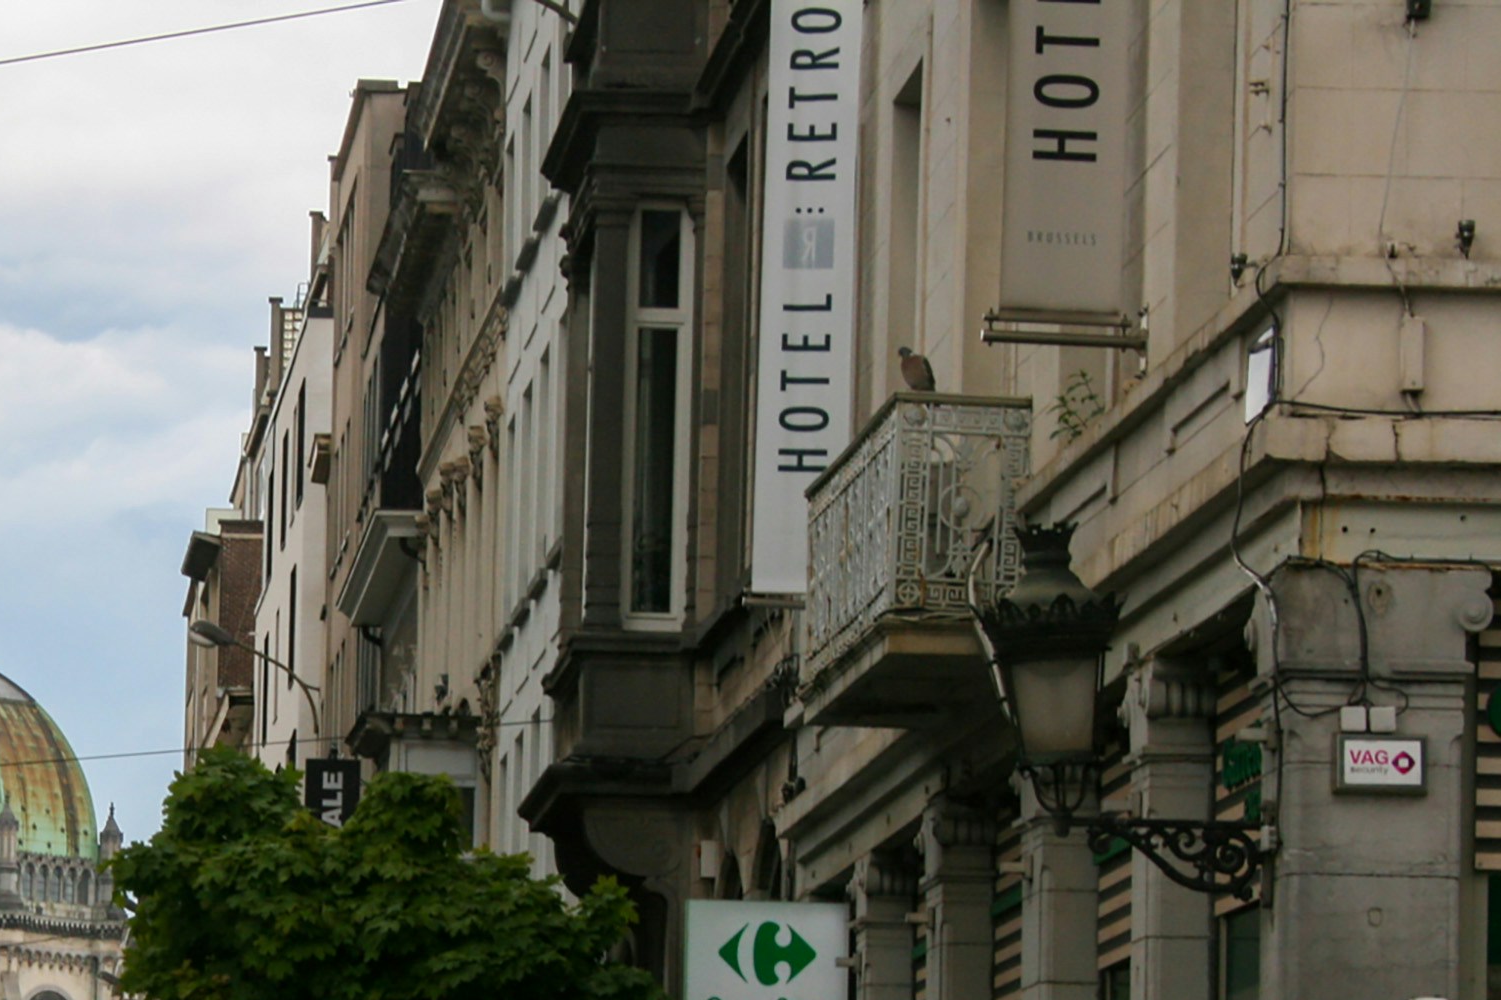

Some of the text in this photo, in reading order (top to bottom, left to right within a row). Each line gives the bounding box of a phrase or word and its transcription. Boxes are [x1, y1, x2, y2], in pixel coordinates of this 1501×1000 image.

[1032, 0, 1100, 161] HOT
[777, 6, 843, 473] HOTEL RETRO
[1027, 230, 1098, 246] BRUSSELS
[1349, 750, 1388, 764] VAG
[1350, 765, 1389, 775] security
